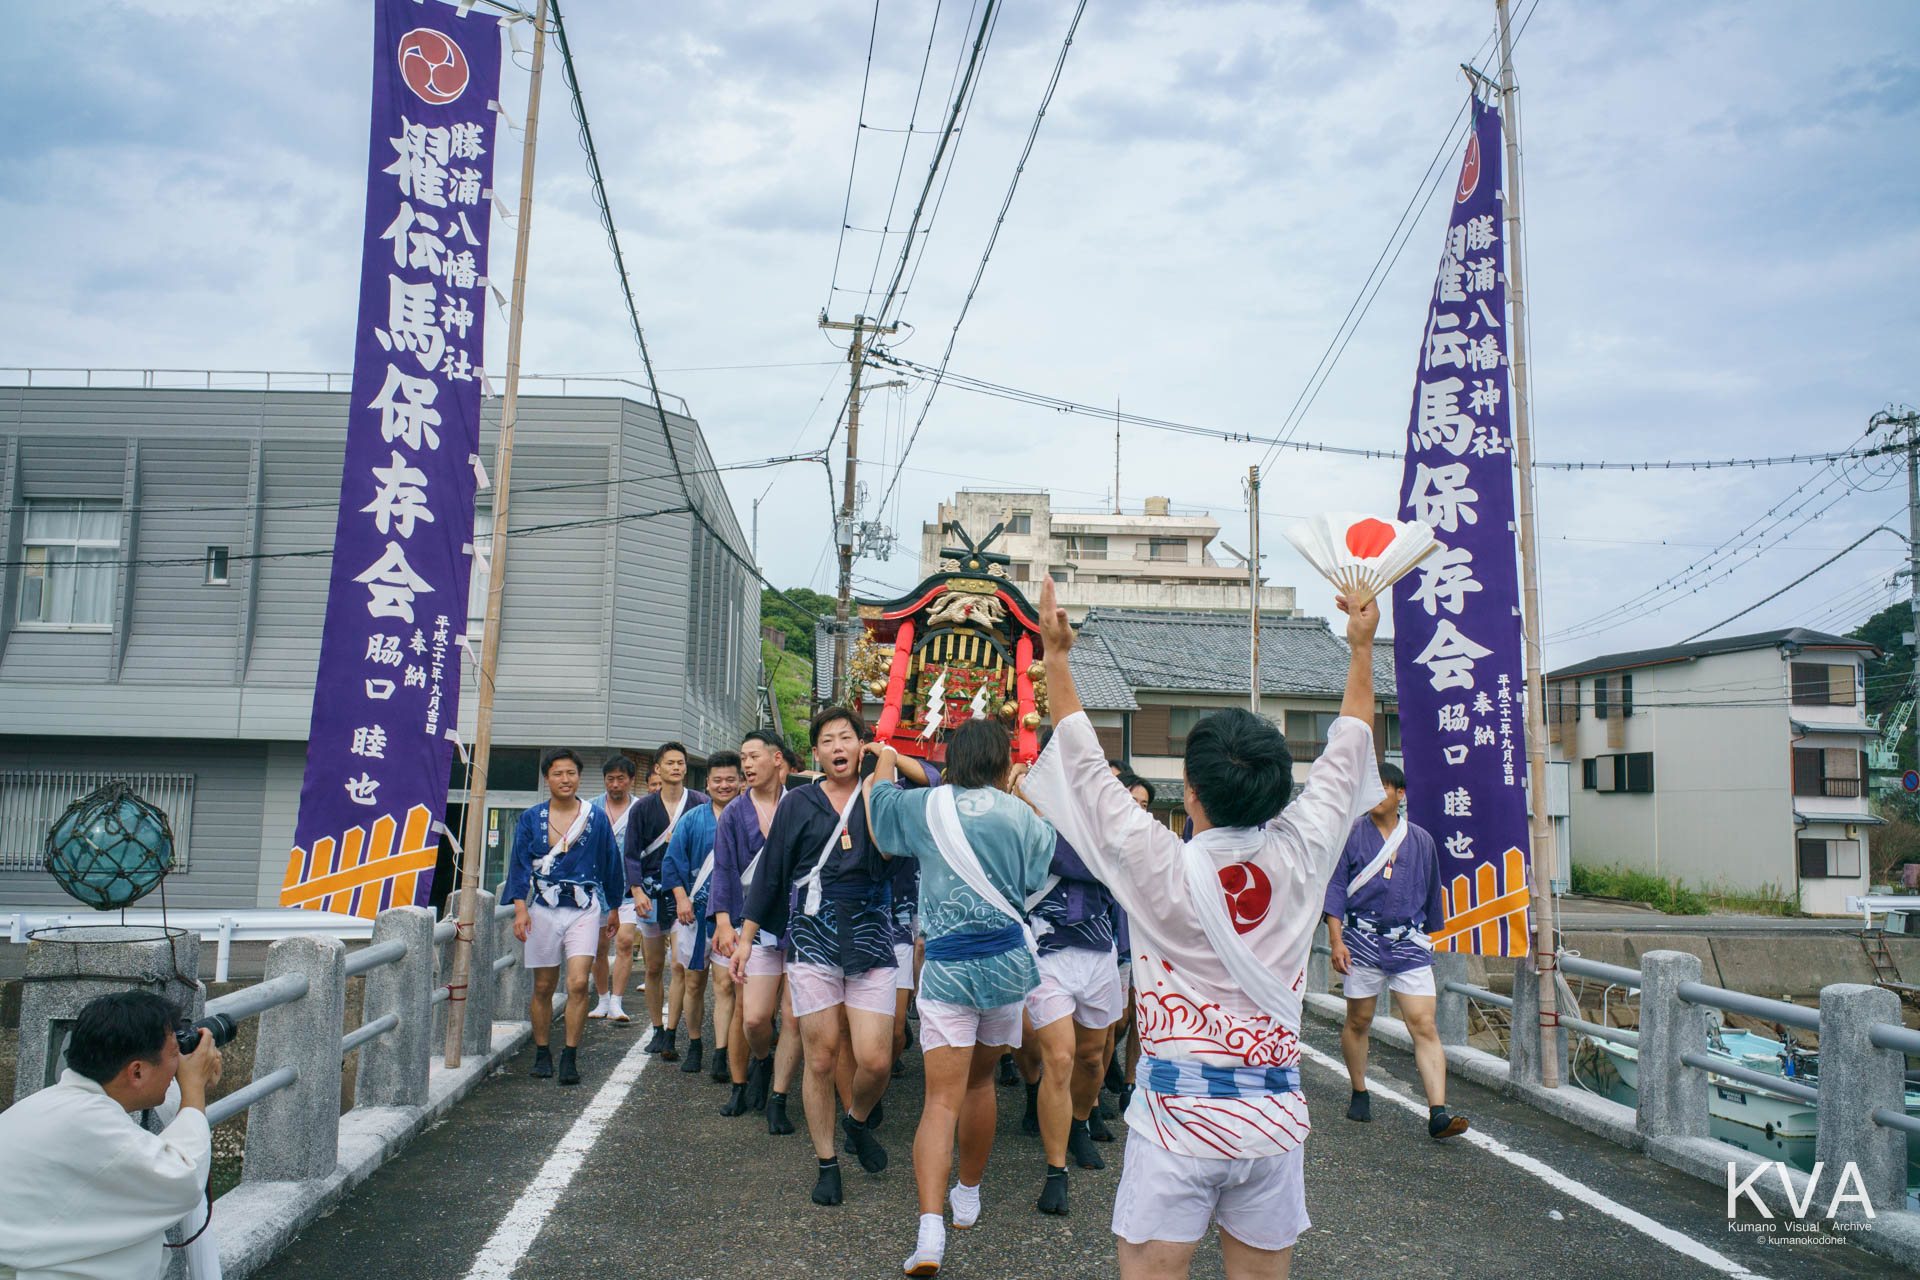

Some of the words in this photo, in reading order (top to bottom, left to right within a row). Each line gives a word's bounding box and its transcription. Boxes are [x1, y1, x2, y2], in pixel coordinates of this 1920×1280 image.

[440, 122, 487, 382] 勝浦八幡神社
[1465, 214, 1506, 459] 勝浦八幡神社
[404, 628, 428, 690] 奉納
[425, 614, 450, 736] 平成二十一年九月吉日
[1472, 690, 1495, 747] 奉納
[1497, 674, 1514, 786] 平成二十一年九月吉日
